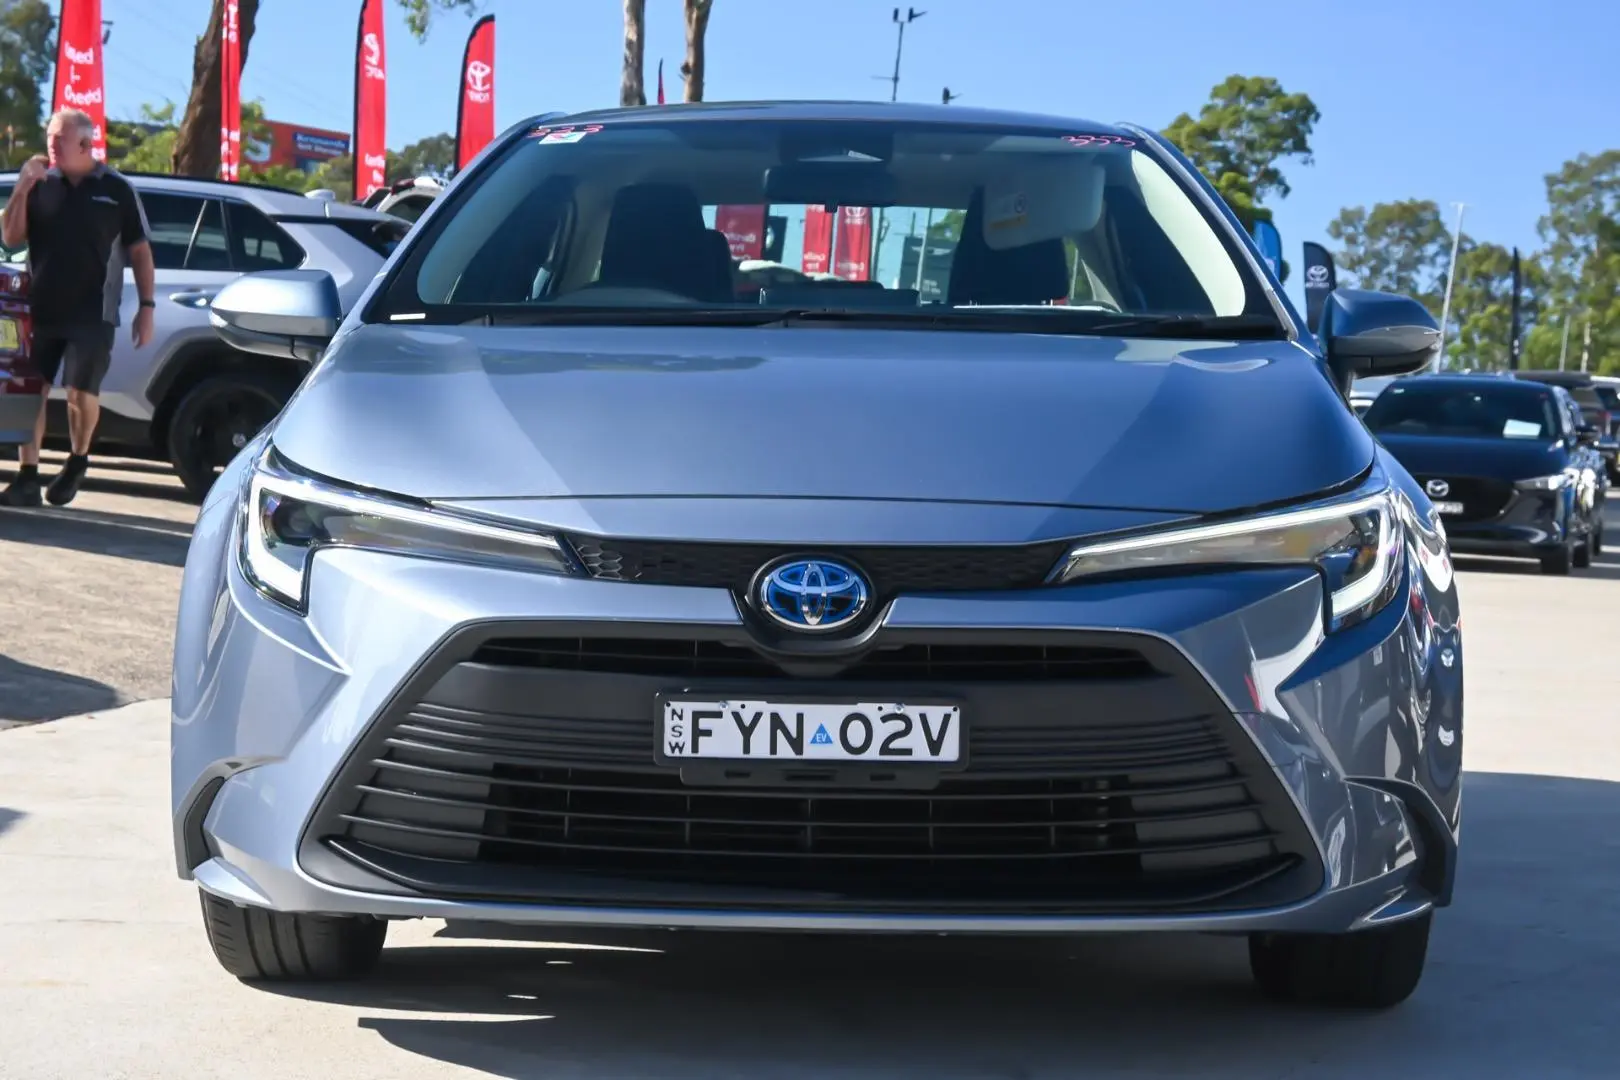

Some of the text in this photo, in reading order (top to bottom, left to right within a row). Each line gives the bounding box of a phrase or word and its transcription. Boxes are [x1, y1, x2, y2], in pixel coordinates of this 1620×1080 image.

[669, 708, 686, 754] NSW
[691, 710, 952, 757] FYN 02V
[816, 733, 827, 742] EV
